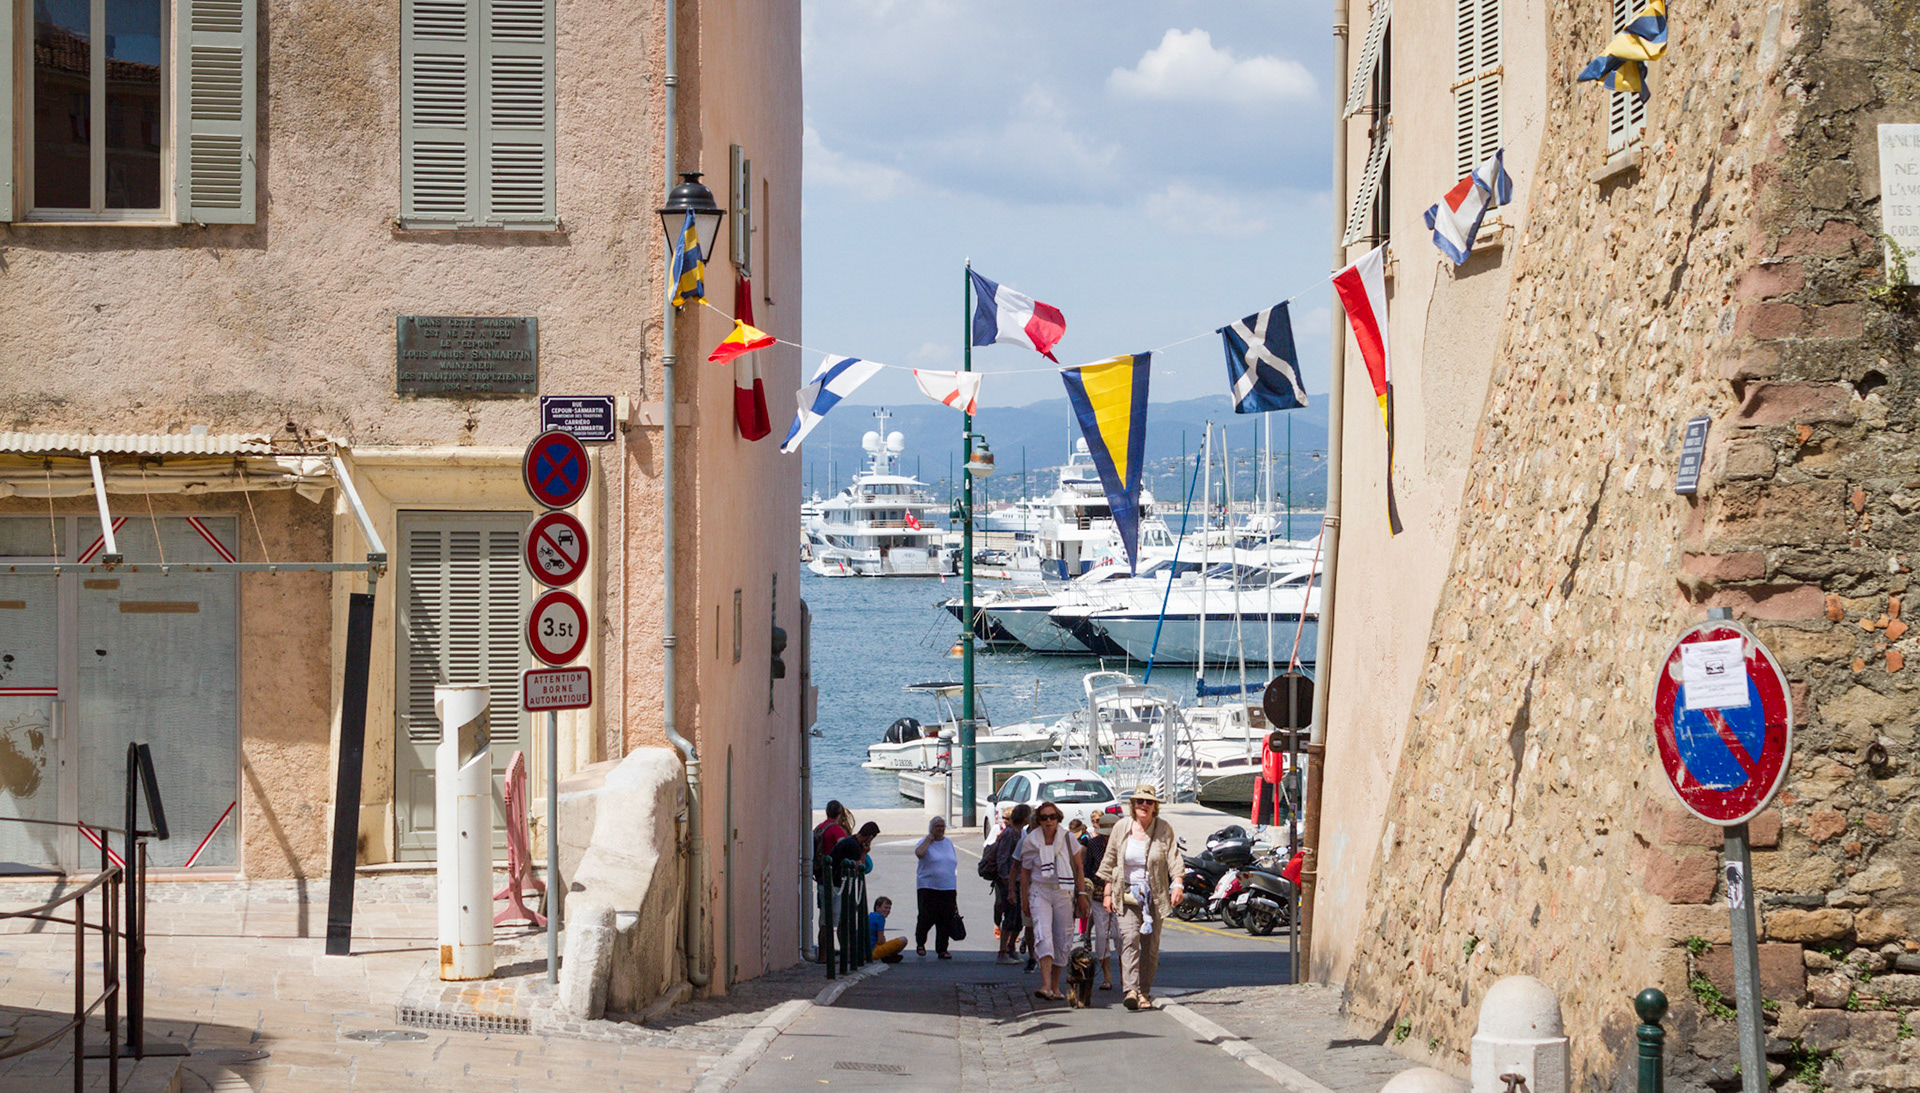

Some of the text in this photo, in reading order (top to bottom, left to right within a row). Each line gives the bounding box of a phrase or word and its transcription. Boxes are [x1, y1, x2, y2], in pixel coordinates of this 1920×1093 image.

[1890, 204, 1912, 217] TES
[419, 319, 515, 328] DANS CETTE MAISON
[424, 329, 440, 338] EST
[463, 329, 474, 338] ET
[441, 340, 452, 348] LE
[403, 350, 532, 360] LOUIS MARIUS SANMARTIN
[440, 361, 496, 371] MAINTENEUR
[418, 372, 469, 382] TRADITIONS
[471, 372, 535, 383] TROPEZIENNES
[534, 673, 582, 684] ATTENTION
[543, 684, 573, 694] BORNE
[530, 694, 587, 705] AUTOMATIQUE
